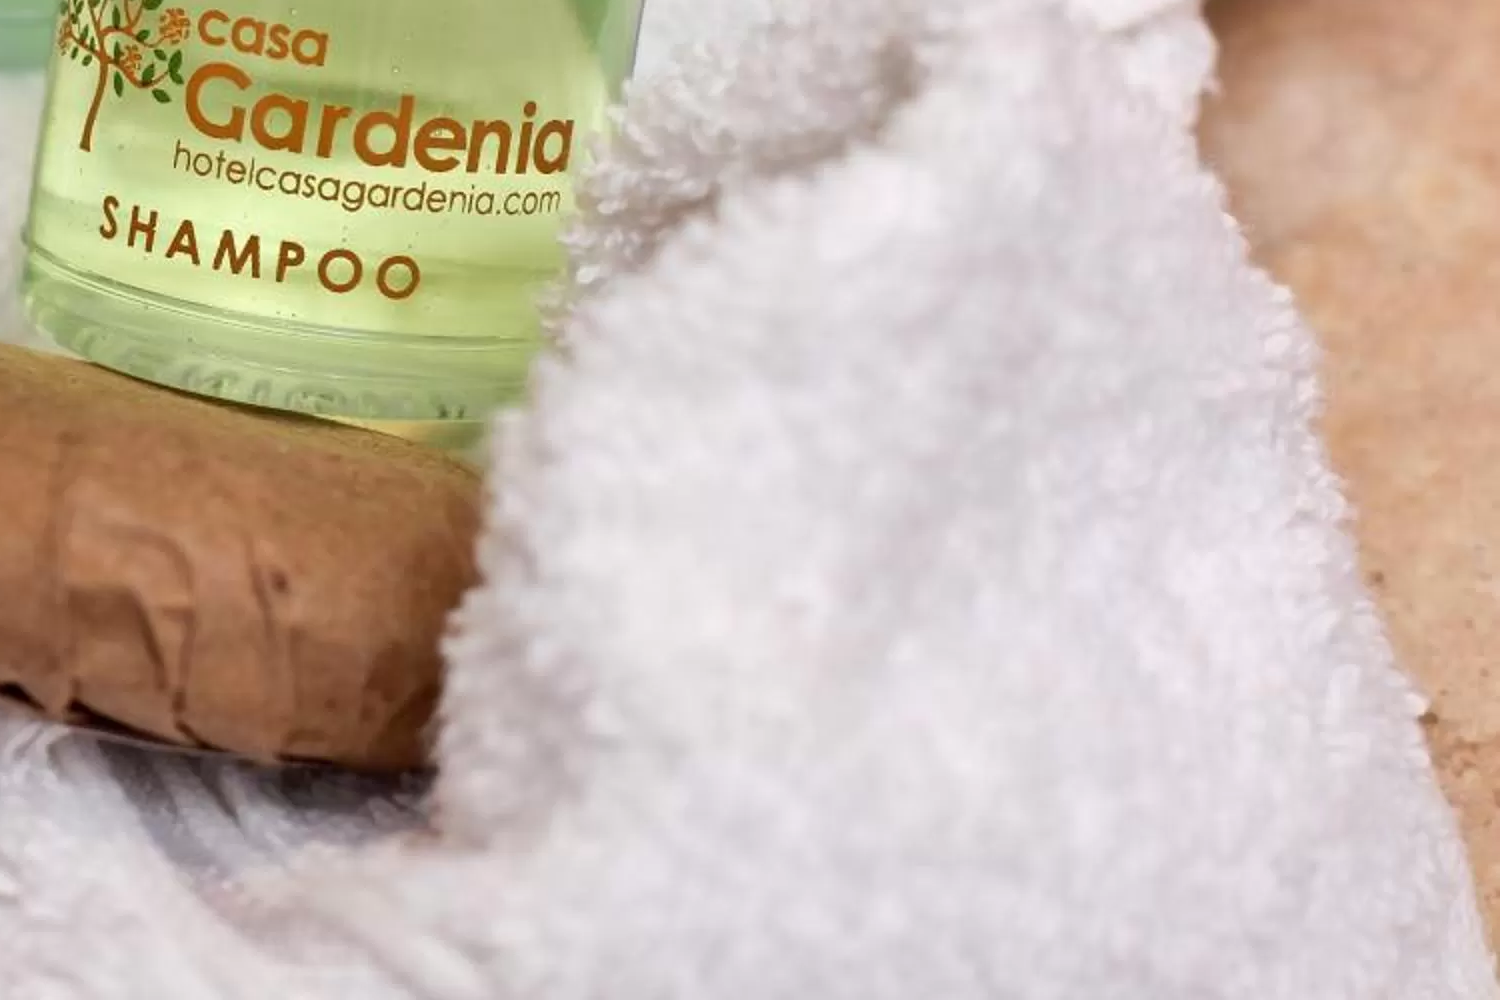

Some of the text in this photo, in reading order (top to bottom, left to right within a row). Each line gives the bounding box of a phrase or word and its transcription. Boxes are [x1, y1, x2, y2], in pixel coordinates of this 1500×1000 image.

[197, 9, 330, 67] casa
[185, 62, 575, 176] Gardenia
[173, 139, 562, 216] hotelcasagardenia.com
[99, 196, 421, 301] SHAMPOO
